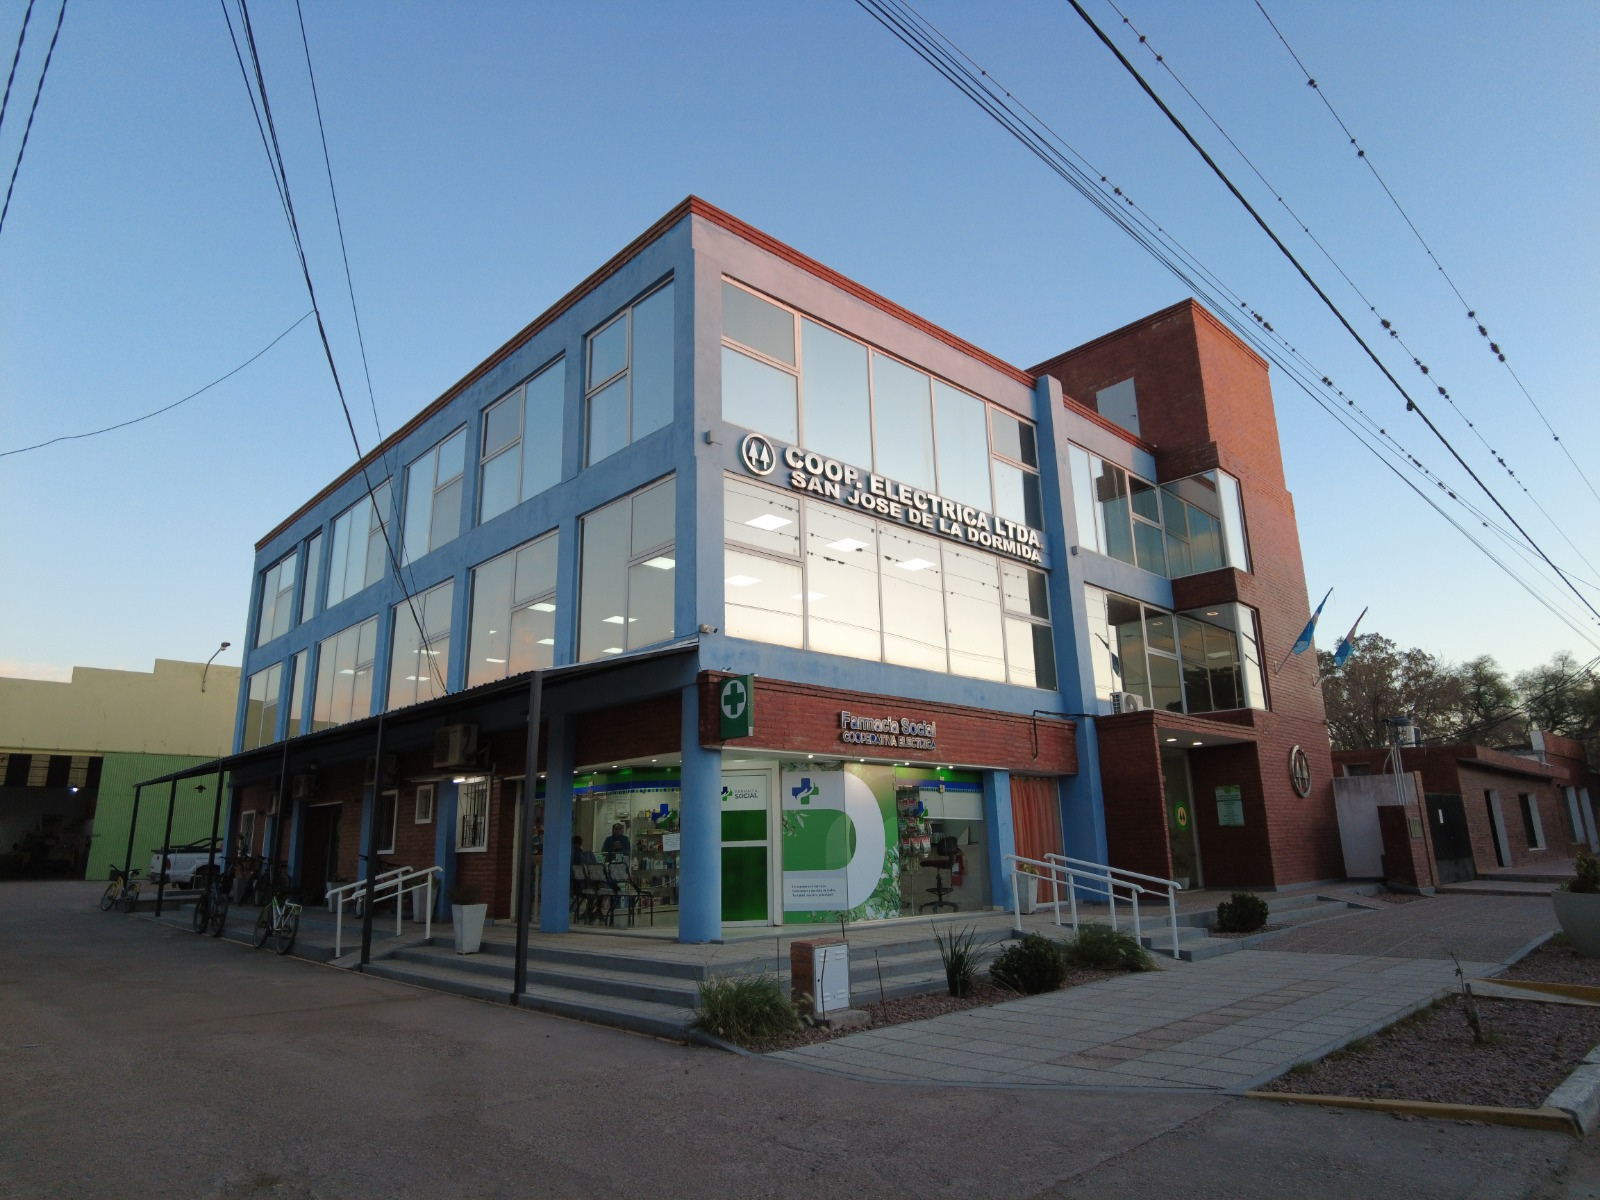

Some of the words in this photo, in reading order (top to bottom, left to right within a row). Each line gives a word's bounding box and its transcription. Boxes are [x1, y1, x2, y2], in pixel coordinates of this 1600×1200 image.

[785, 446, 863, 489] COOP.
[869, 473, 990, 531] ELECTRICA
[791, 471, 840, 500] SAN
[847, 489, 902, 520] JOSE
[908, 508, 934, 529] DE
[939, 517, 963, 539] LA
[967, 526, 1042, 564] DORMIDA
[841, 710, 900, 734] Farmacia
[900, 717, 937, 738] Social
[842, 730, 898, 747] COOPERATIVA
[898, 735, 936, 750] ELECTRICA
